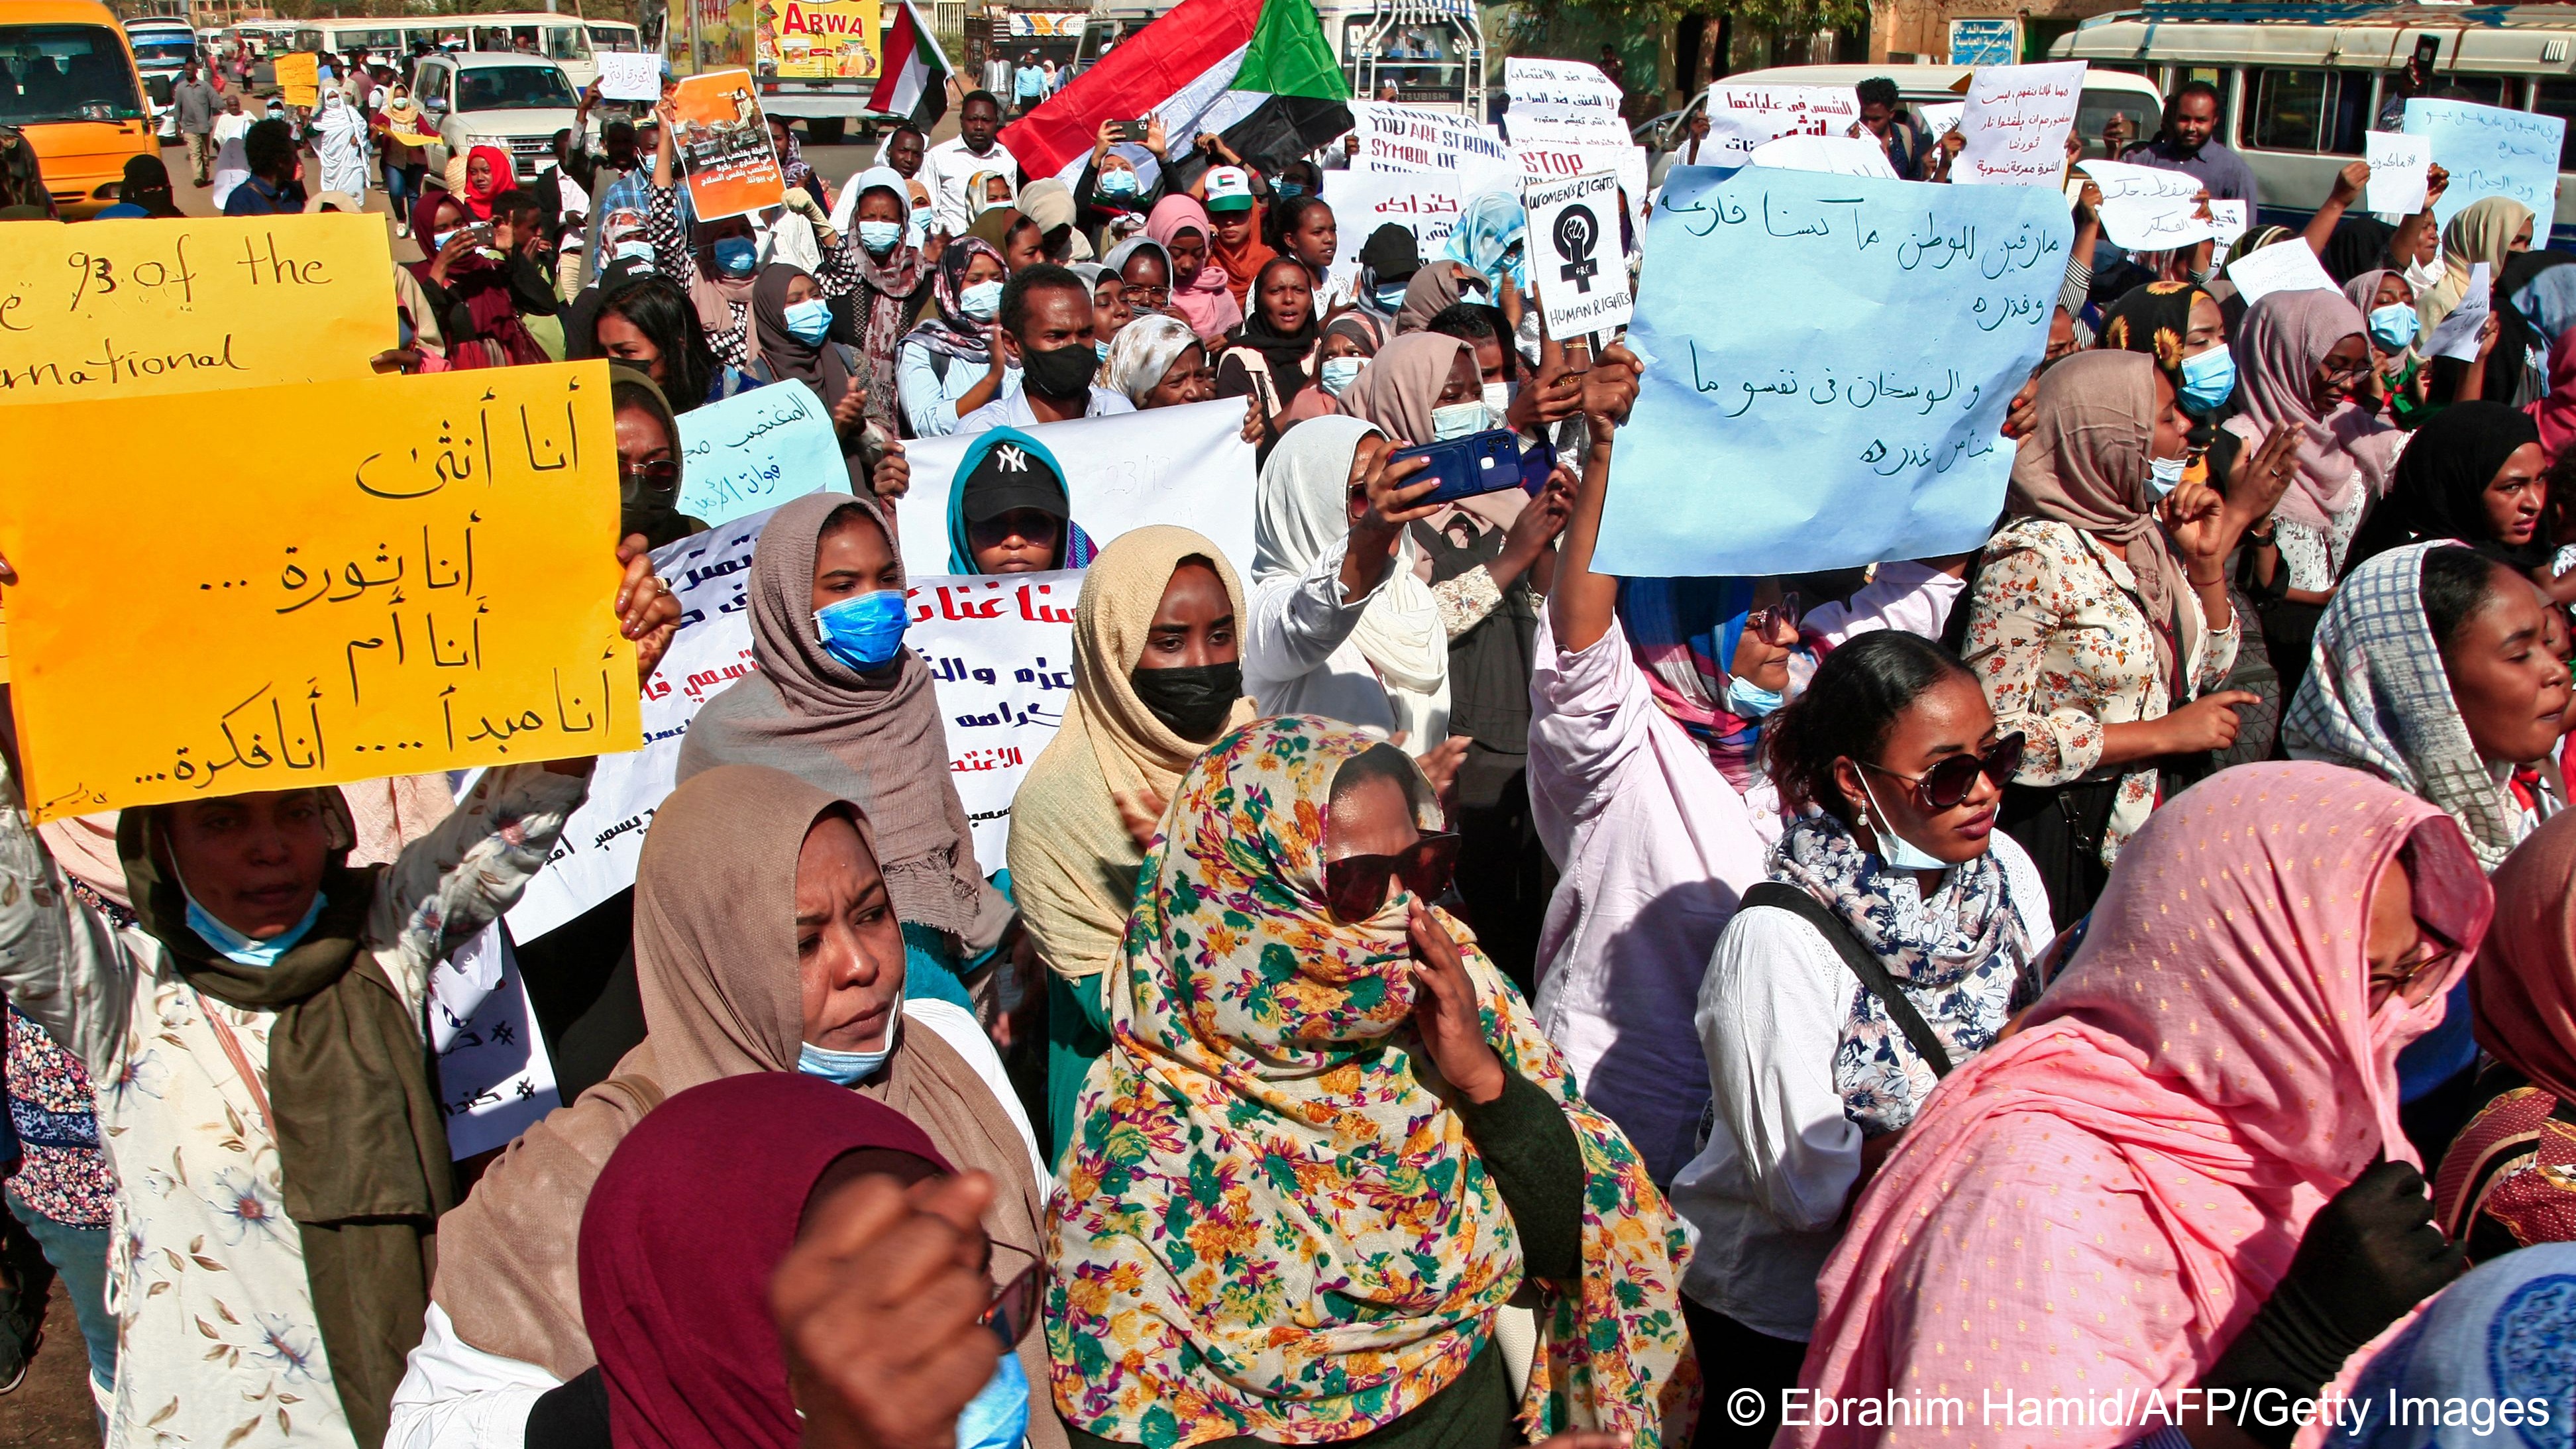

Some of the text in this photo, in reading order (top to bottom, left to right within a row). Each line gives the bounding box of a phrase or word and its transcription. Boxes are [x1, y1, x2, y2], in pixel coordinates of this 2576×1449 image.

[782, 2, 864, 38] ARWA
[1399, 92, 1450, 101] TSUBISHI
[1810, 96, 1852, 116] الشمس
[1368, 115, 1405, 136] YOU
[1410, 123, 1439, 143] ARE
[1443, 131, 1506, 161] STRONG
[1371, 138, 1432, 166] SYMBOL
[1437, 152, 1460, 170] OF
[1519, 151, 1583, 176] STOP
[237, 232, 333, 285] the
[627, 263, 654, 276] PUMA
[1550, 293, 1632, 327] HUMAN RIGHTS
[0, 333, 250, 390] rnational
[725, 392, 814, 453] المغتصب
[275, 541, 404, 614] ثورة
[174, 680, 274, 789] فكرة
[437, 683, 544, 755] مبدأ
